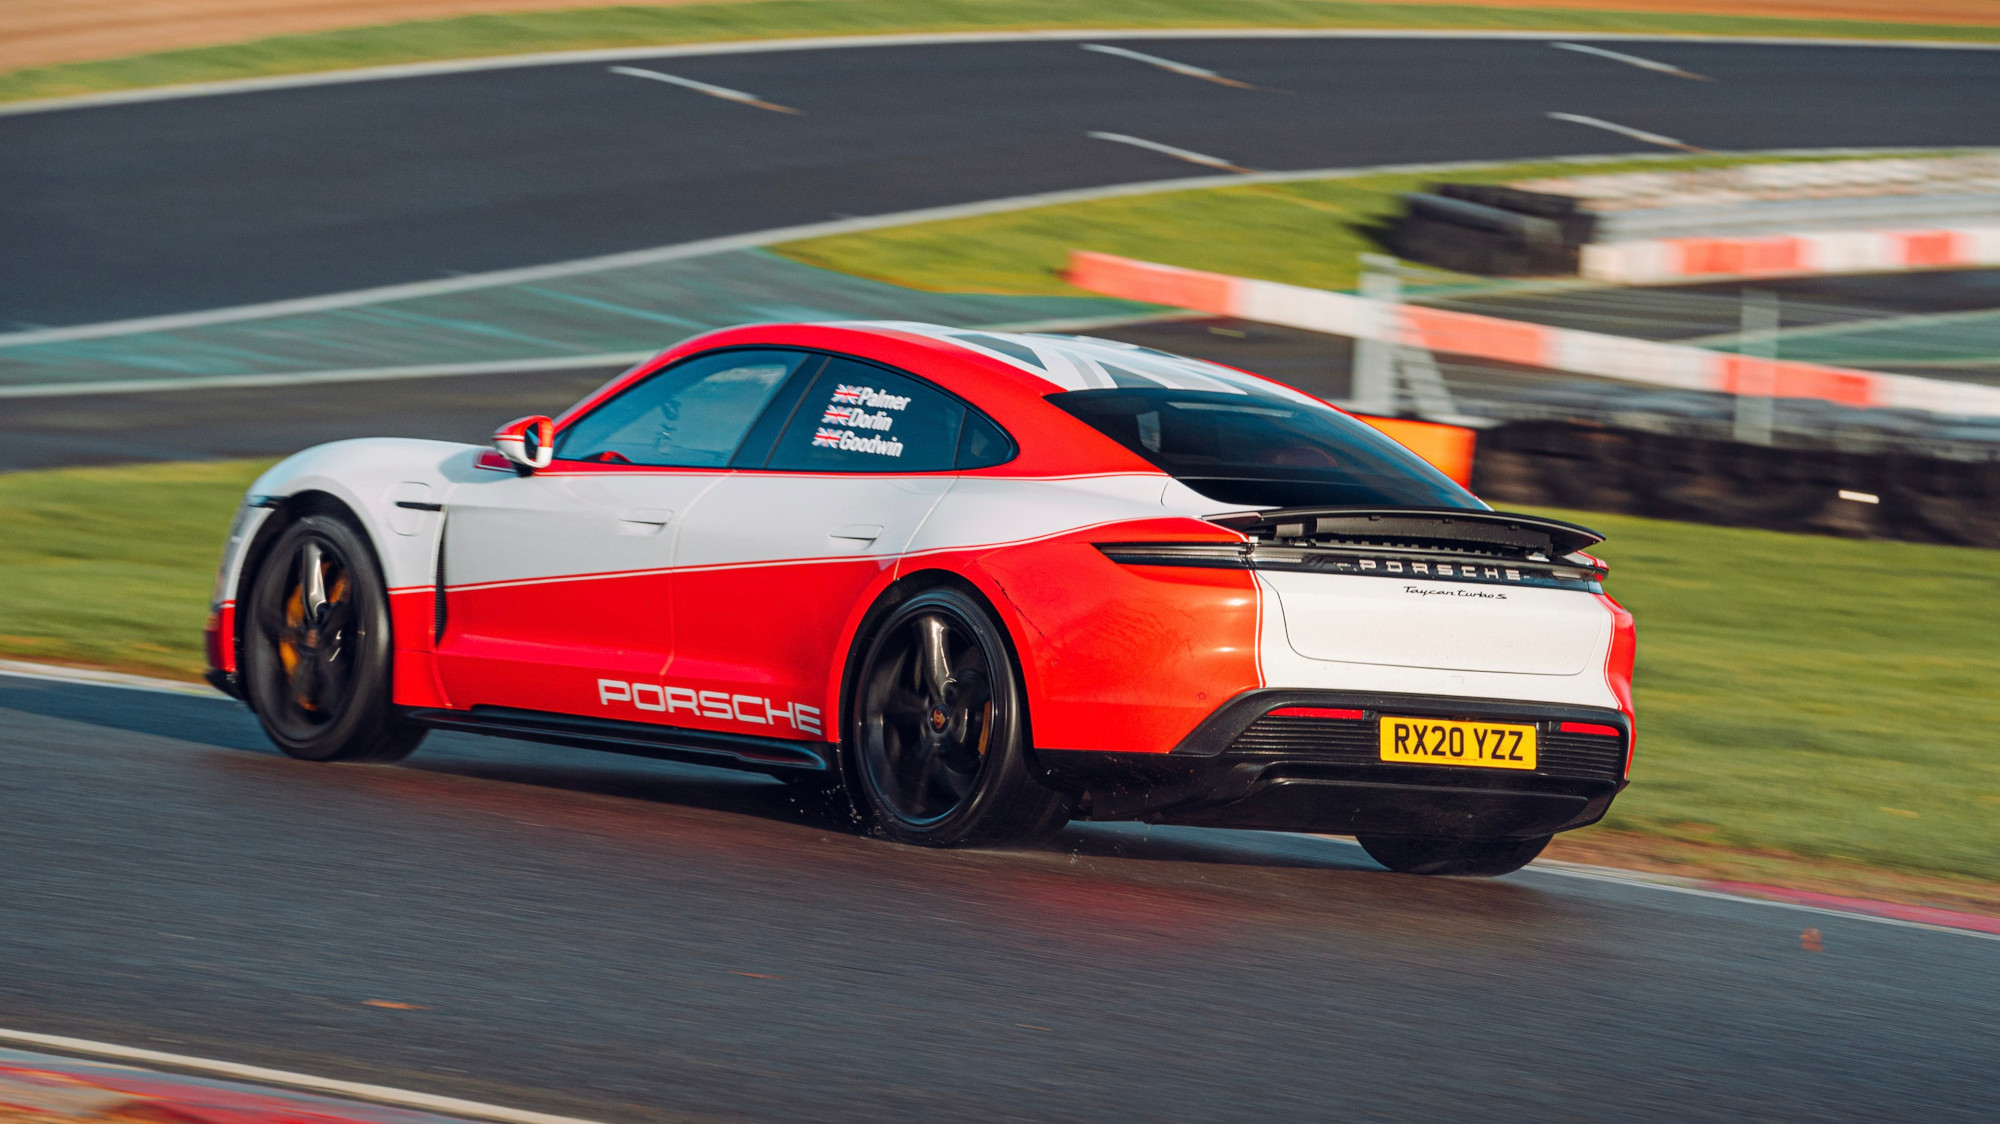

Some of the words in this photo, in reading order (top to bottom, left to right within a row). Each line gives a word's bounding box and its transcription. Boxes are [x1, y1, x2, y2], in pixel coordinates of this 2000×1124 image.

[858, 387, 912, 411] Palmer
[847, 407, 893, 432] Dorlin
[839, 430, 904, 457] Goodwin
[1358, 558, 1522, 581] PORSCHE
[1403, 585, 1455, 597] Taycan
[597, 678, 822, 736] PORSCHE
[1394, 723, 1465, 757] RX20
[1473, 728, 1524, 761] YZZ
